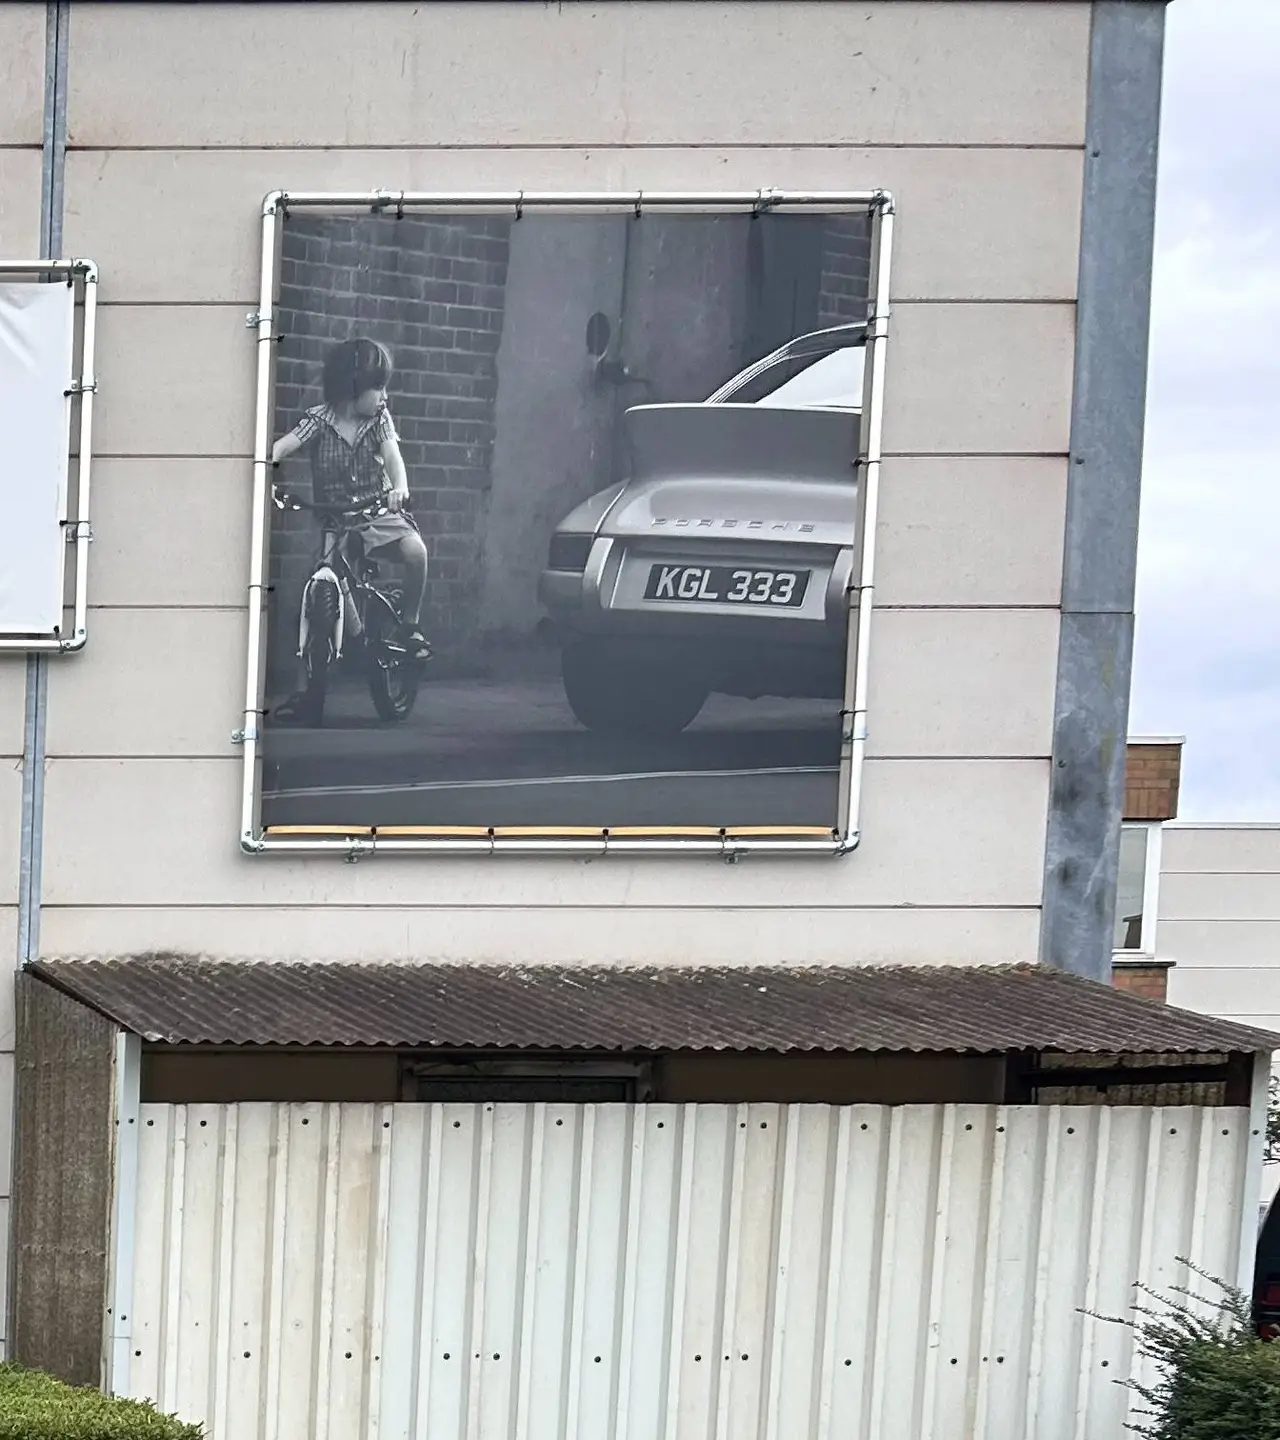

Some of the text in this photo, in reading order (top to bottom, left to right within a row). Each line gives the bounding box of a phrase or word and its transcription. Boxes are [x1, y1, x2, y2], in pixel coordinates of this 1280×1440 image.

[651, 517, 816, 533] PORSCHE
[655, 567, 797, 604] KGL 333
